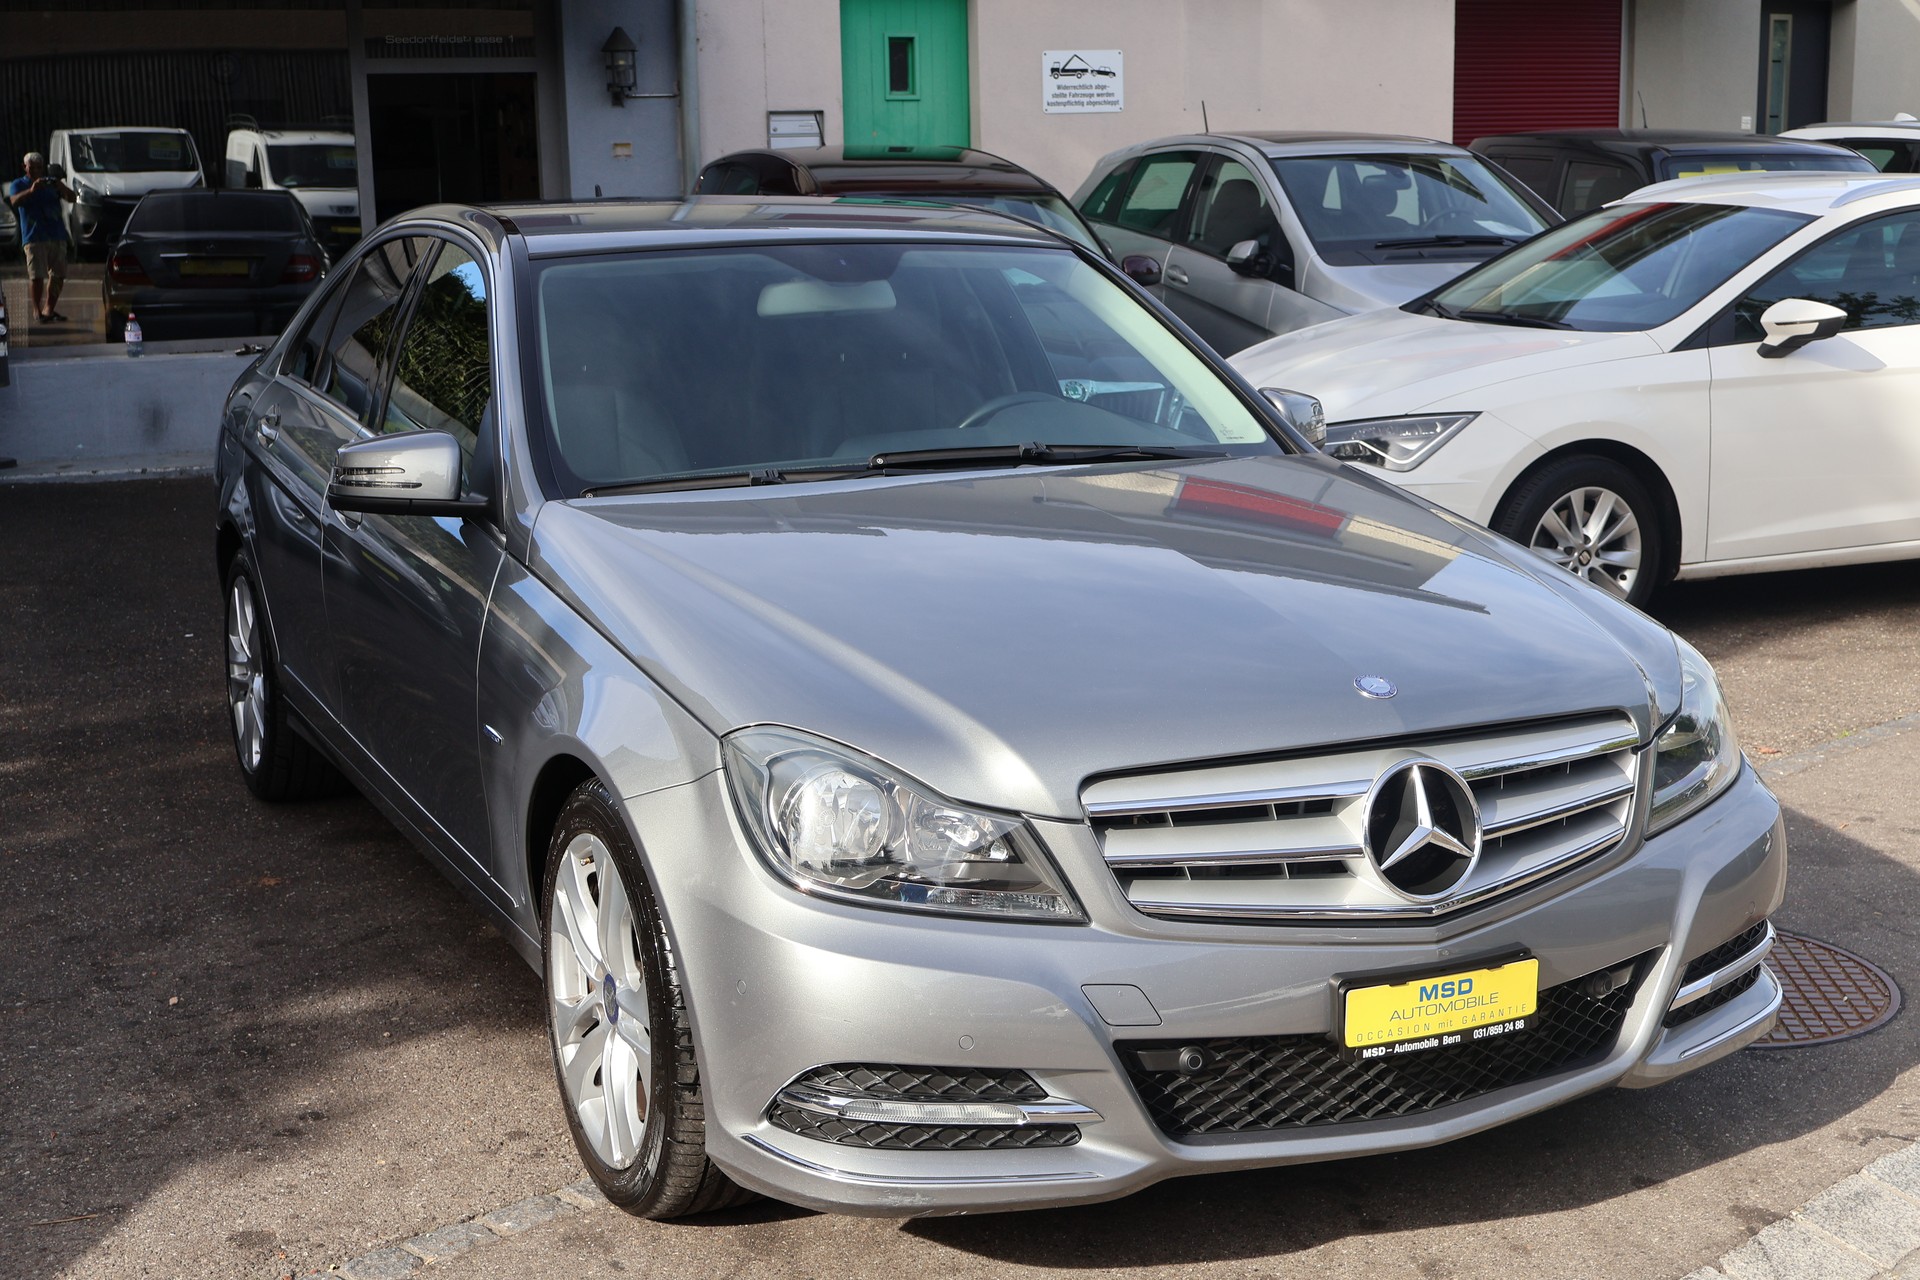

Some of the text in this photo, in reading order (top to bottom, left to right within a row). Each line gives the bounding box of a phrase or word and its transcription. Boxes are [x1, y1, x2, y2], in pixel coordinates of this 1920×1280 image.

[1389, 992, 1499, 1022] AUTOMOBILE
[1419, 978, 1473, 1003] MSD
[1356, 1003, 1528, 1043] OCCASION mit GARANTIE
[1362, 1046, 1386, 1059] MSD
[1393, 1037, 1439, 1054] Automobile
[1442, 1034, 1461, 1046] Bern
[1473, 1023, 1503, 1039] 031/859
[1504, 1021, 1514, 1033] 24
[1514, 1019, 1525, 1030] 88
